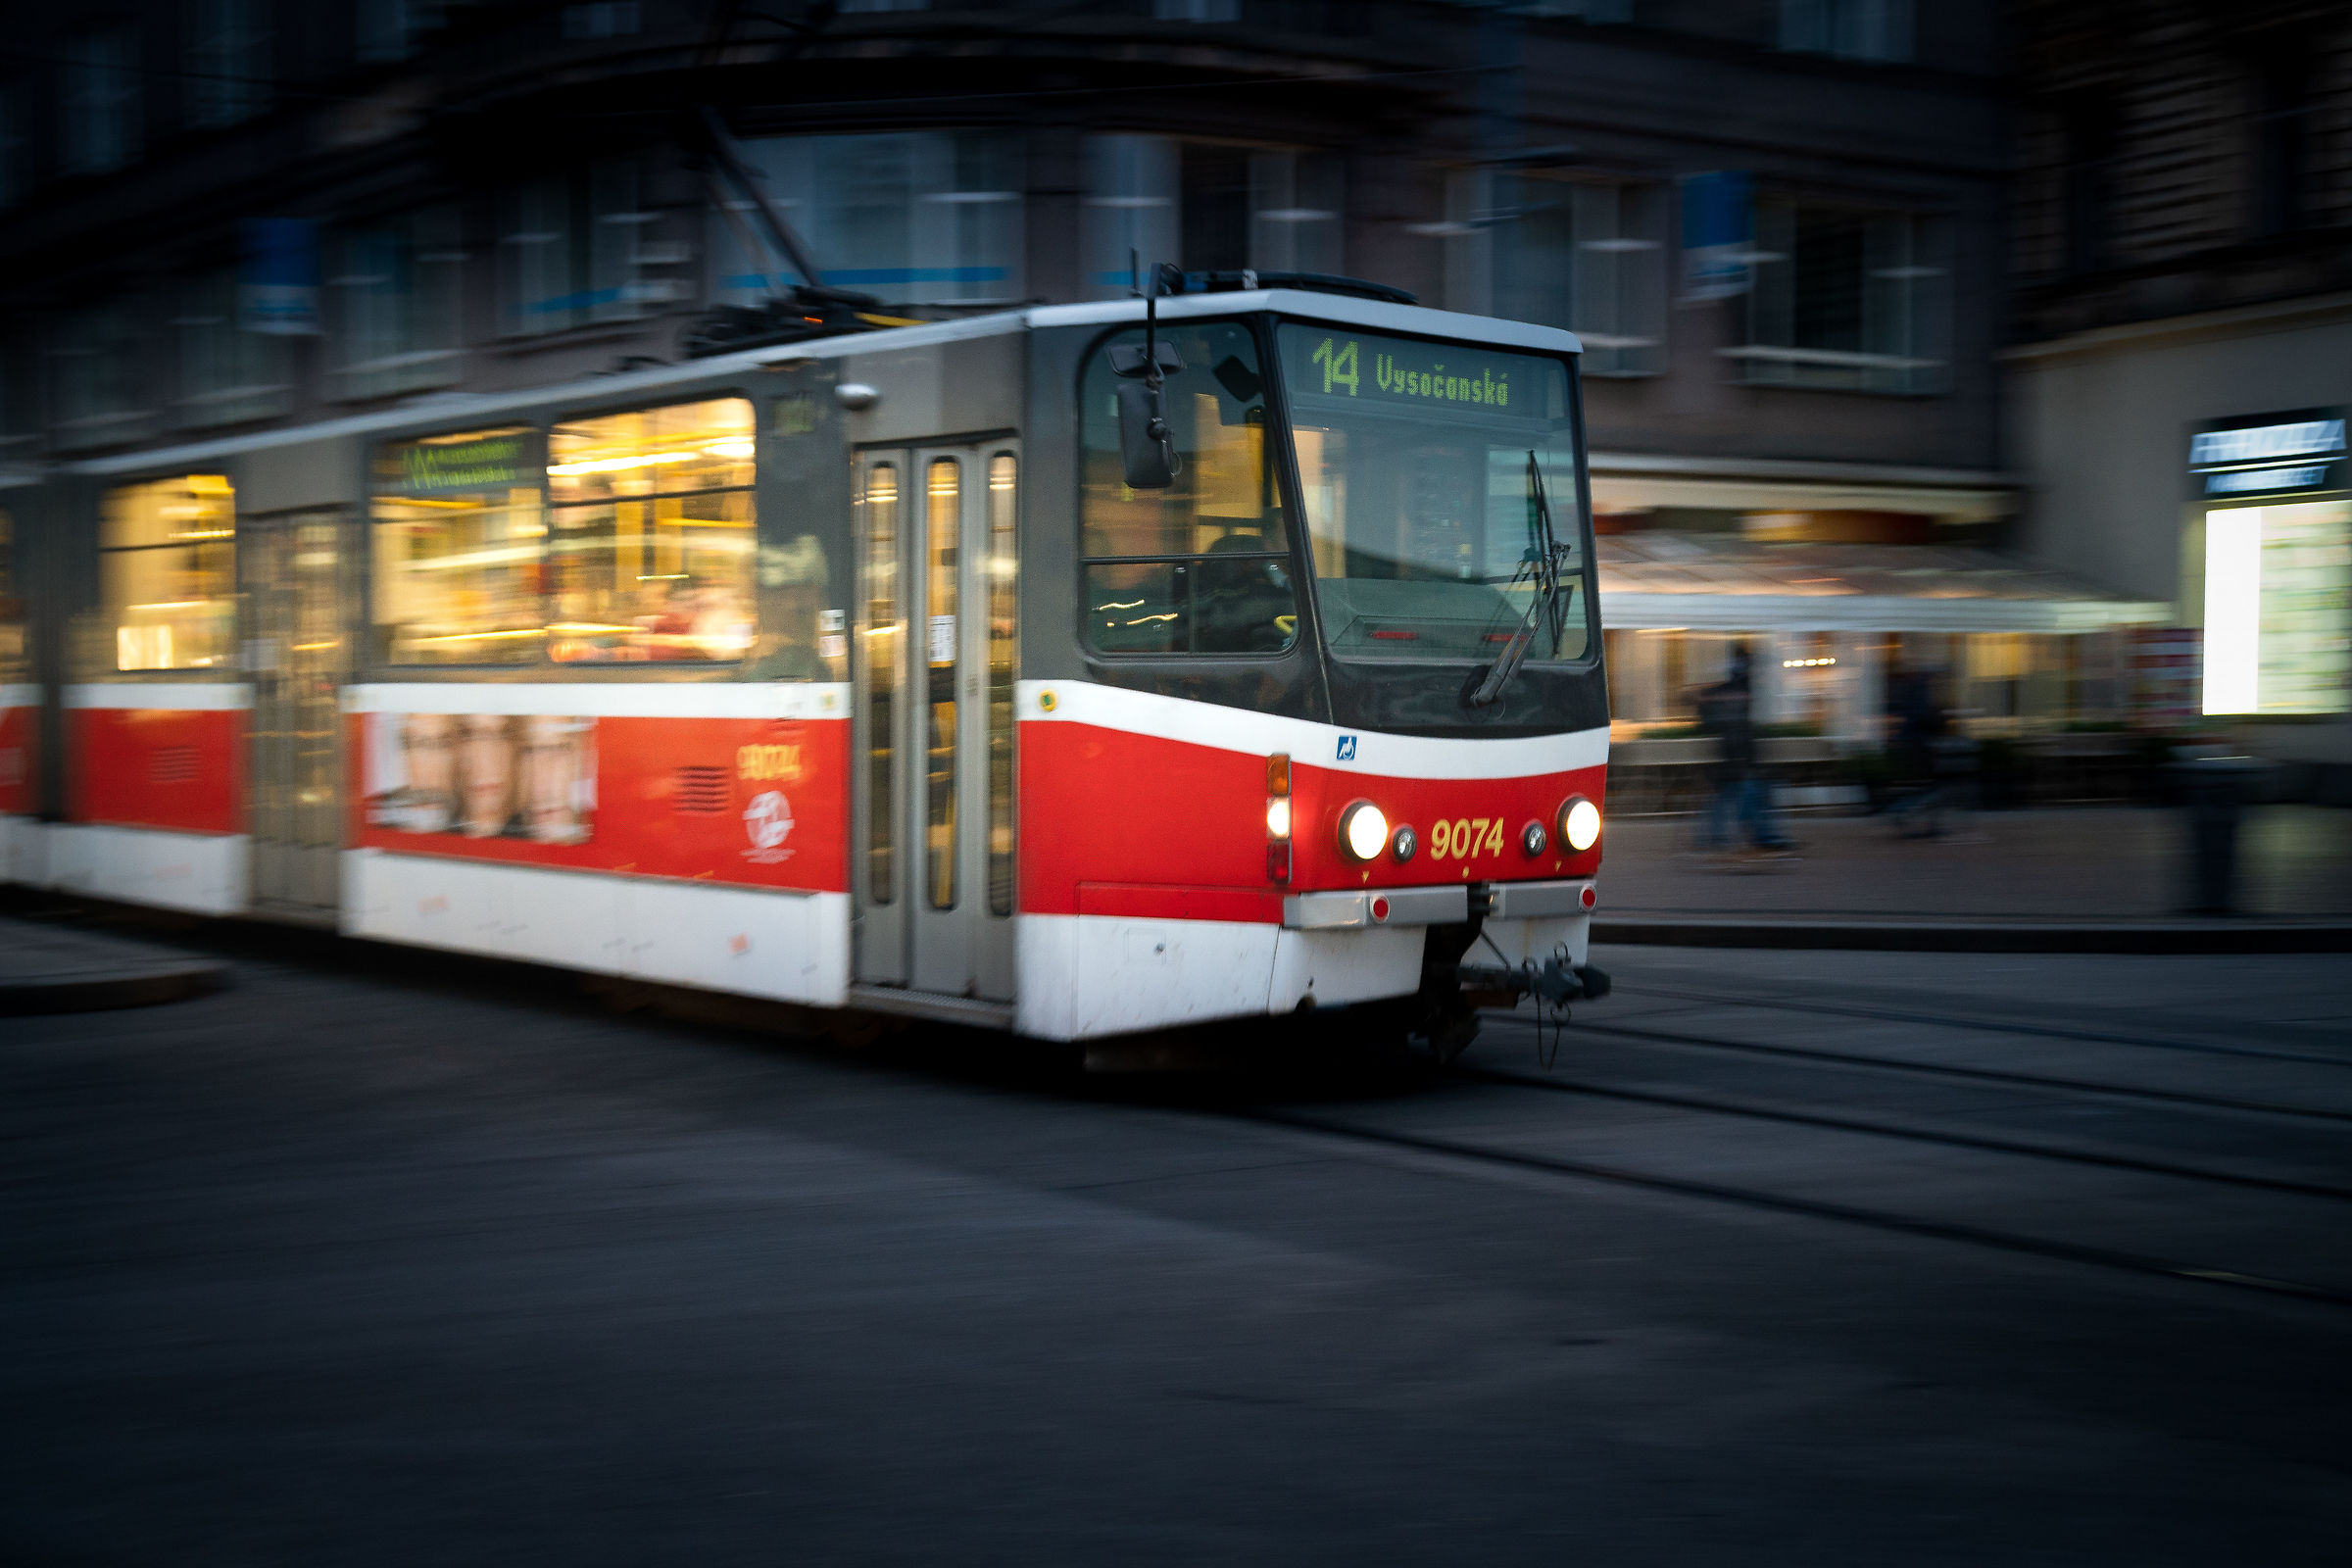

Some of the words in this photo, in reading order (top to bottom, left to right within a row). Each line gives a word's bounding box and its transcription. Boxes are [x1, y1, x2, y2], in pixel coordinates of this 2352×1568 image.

[1312, 338, 1359, 397] 14
[1376, 353, 1509, 406] Vysočanská
[1430, 817, 1505, 860] 9074
